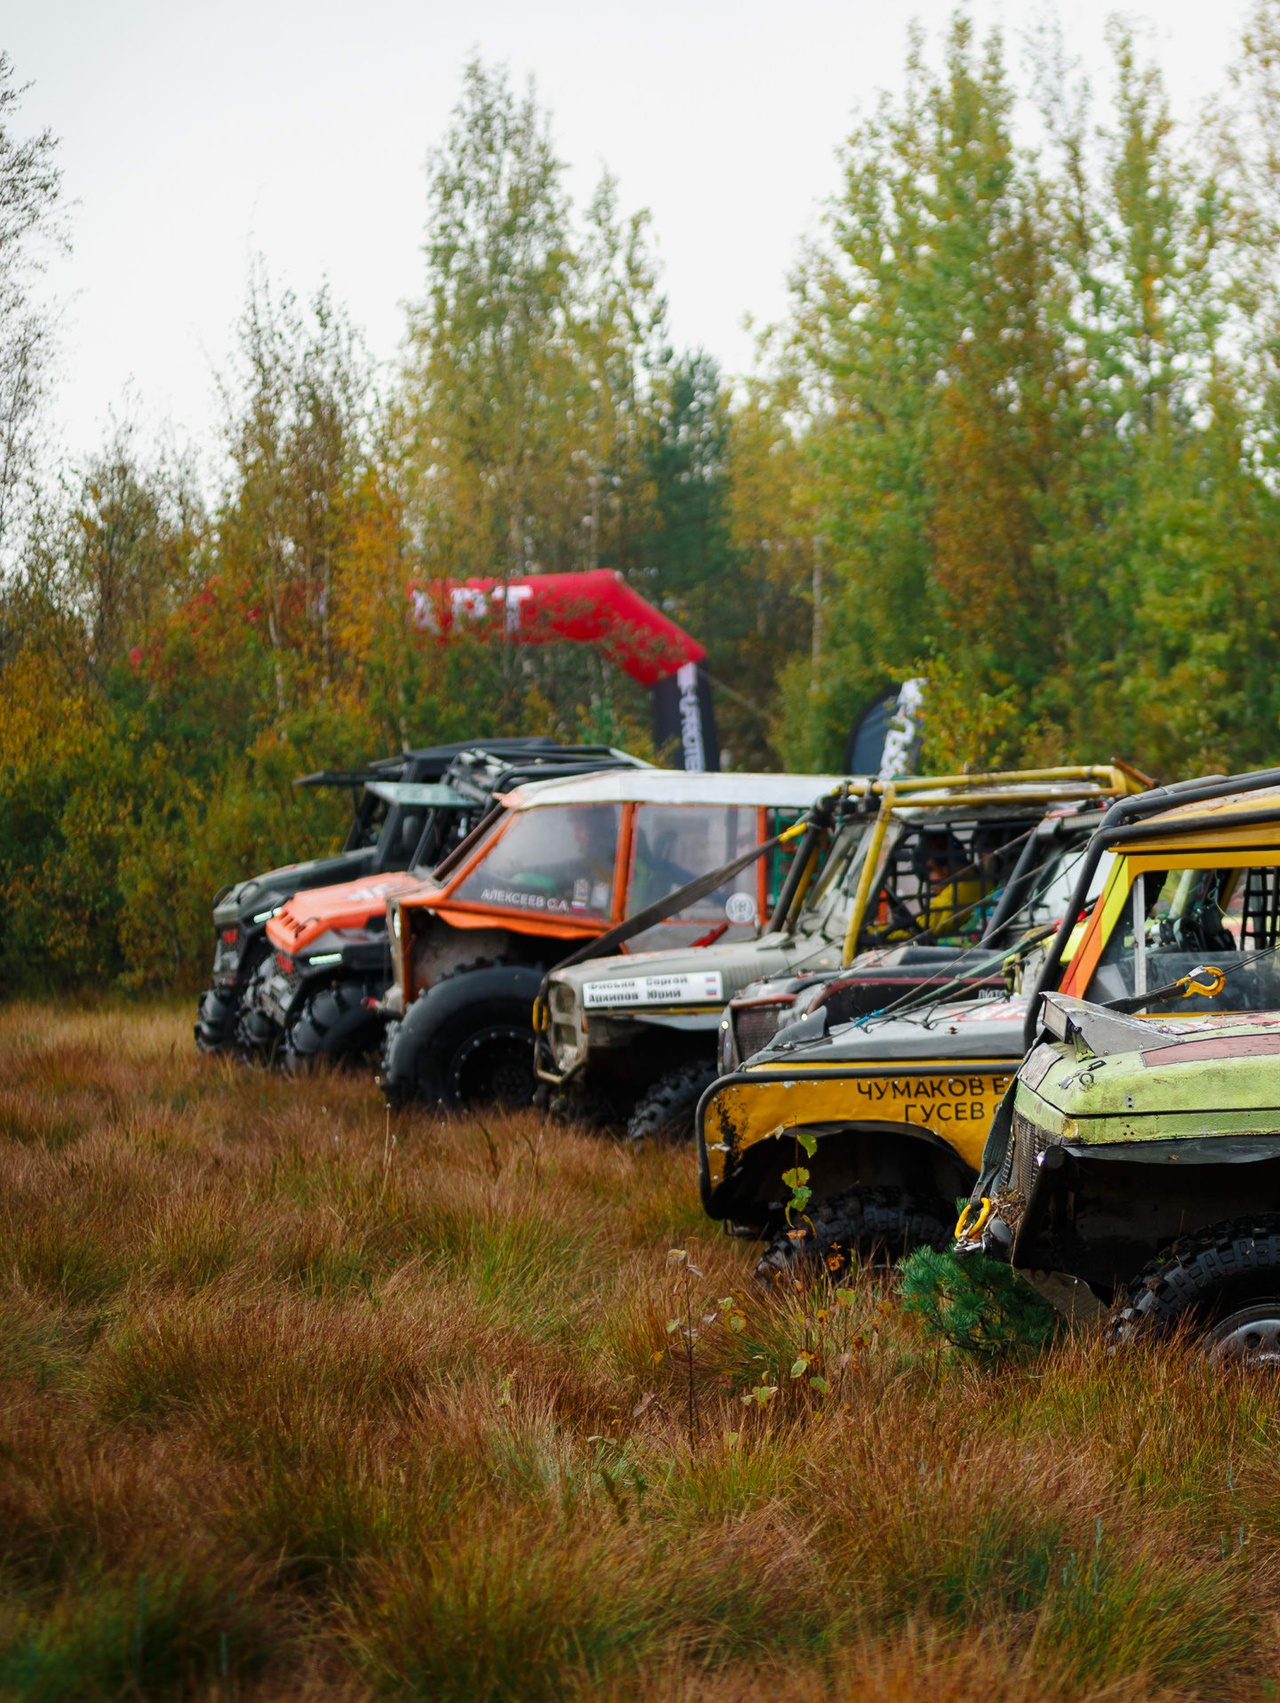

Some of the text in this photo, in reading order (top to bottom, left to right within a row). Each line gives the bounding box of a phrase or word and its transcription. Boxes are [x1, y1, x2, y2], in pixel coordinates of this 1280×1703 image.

[480, 888, 544, 907] АЛЕКСЕЕВ
[857, 1078, 985, 1100] ЧУМАКОВ
[904, 1101, 985, 1123] ГУСЕВ
